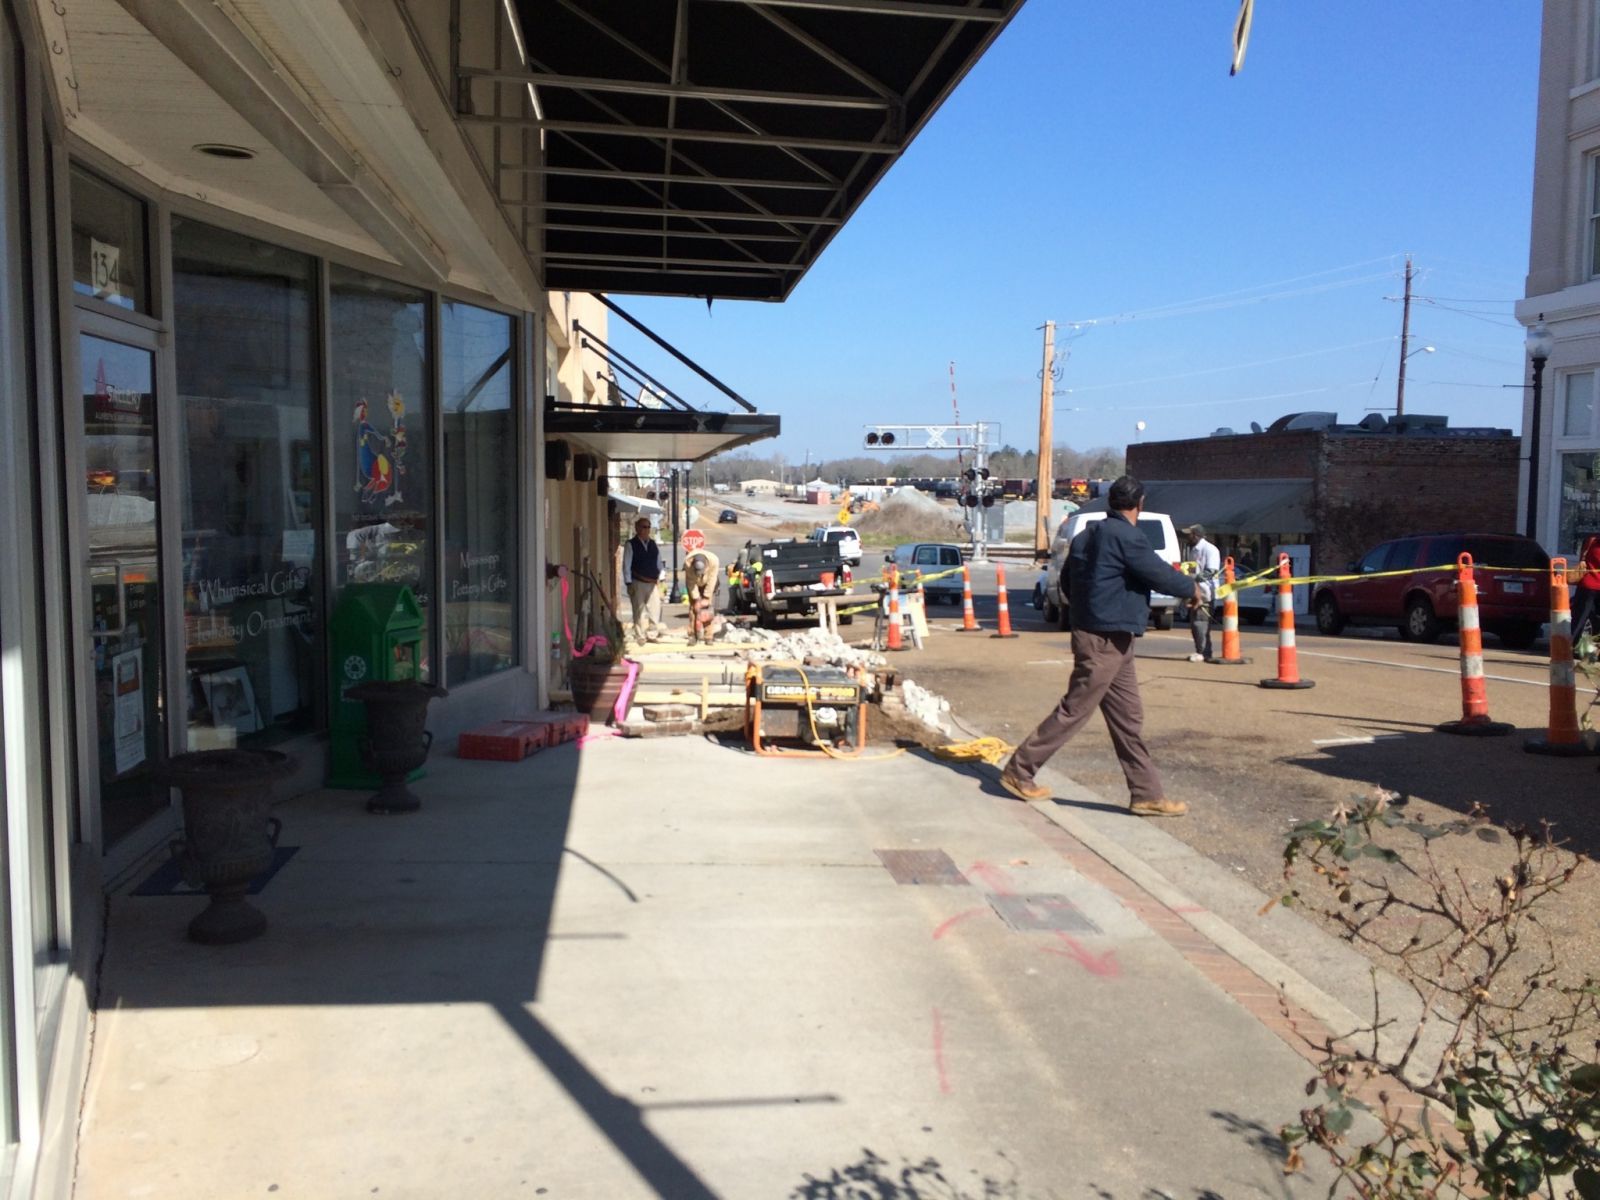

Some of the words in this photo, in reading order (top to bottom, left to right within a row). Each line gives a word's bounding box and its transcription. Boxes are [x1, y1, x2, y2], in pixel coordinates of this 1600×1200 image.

[93, 250, 119, 290] 134
[683, 536, 704, 547] STOP
[199, 571, 269, 603] Whimsical
[270, 569, 306, 596] Gifts
